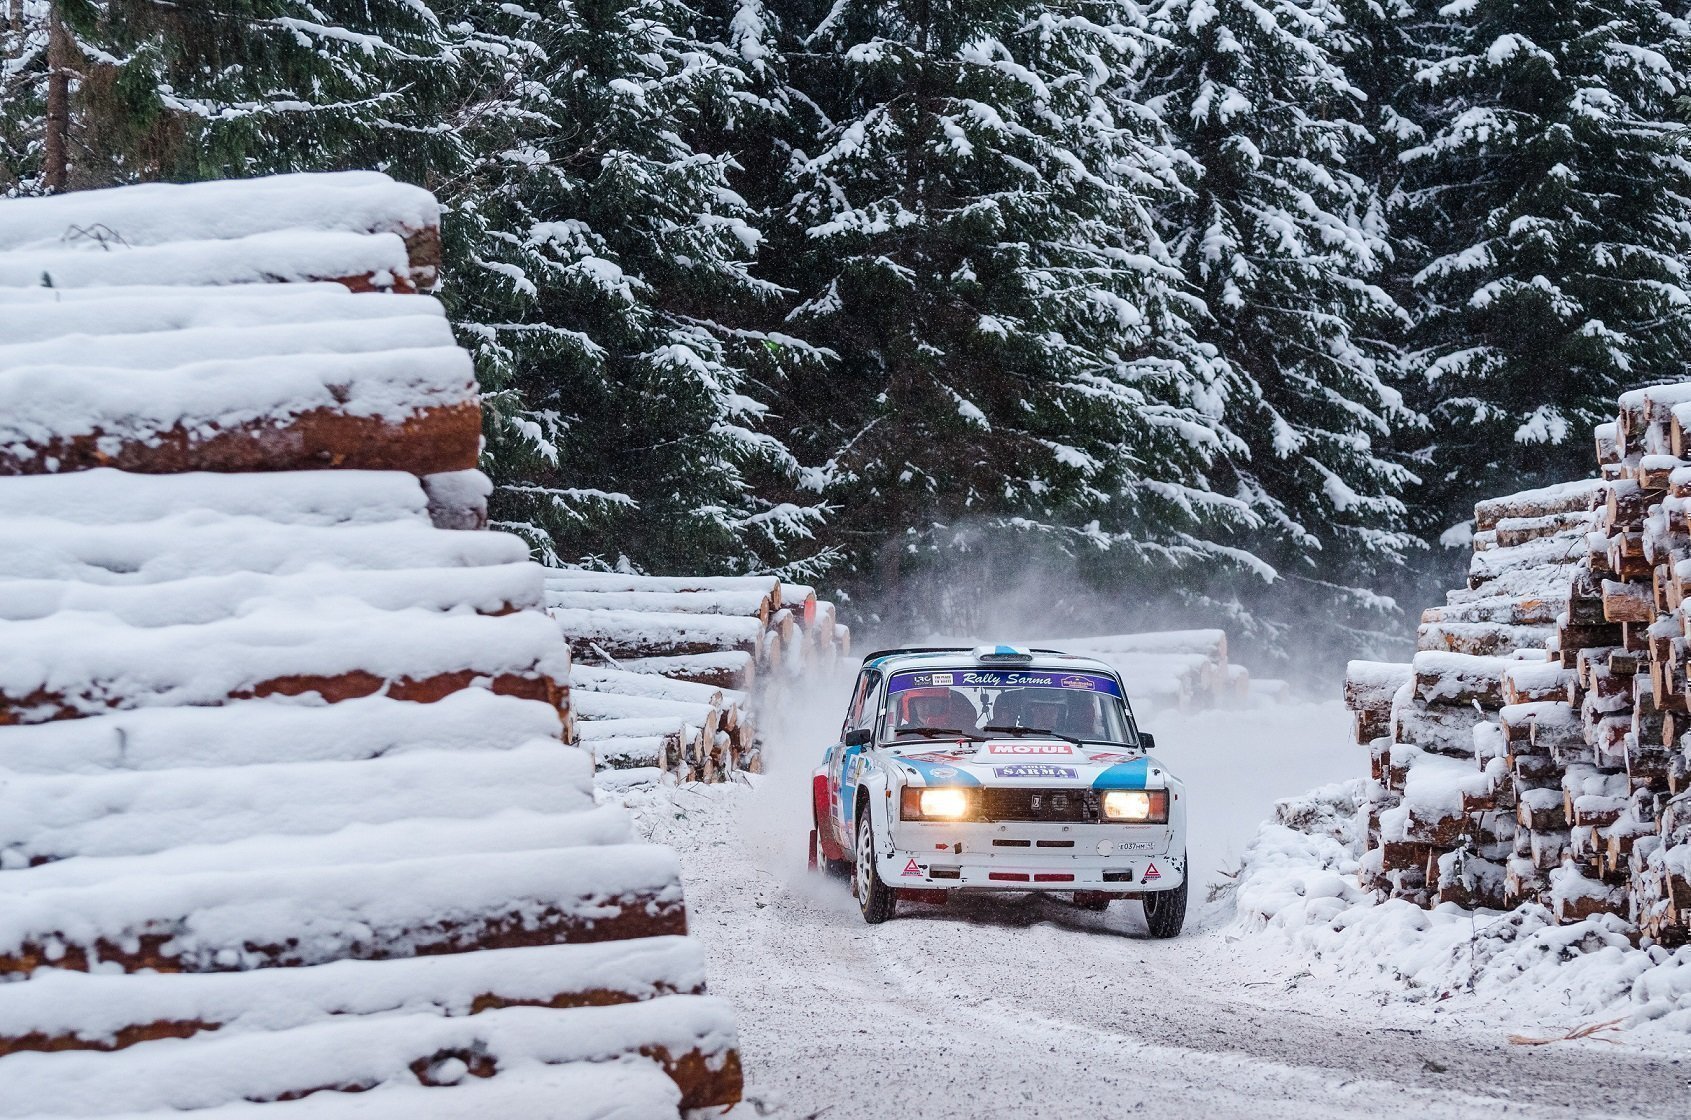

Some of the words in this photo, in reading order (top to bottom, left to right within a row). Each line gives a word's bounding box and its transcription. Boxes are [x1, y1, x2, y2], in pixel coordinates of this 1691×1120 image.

[963, 673, 1000, 686] Rally
[1006, 673, 1053, 684] Sarma
[993, 745, 1069, 754] MOTUL
